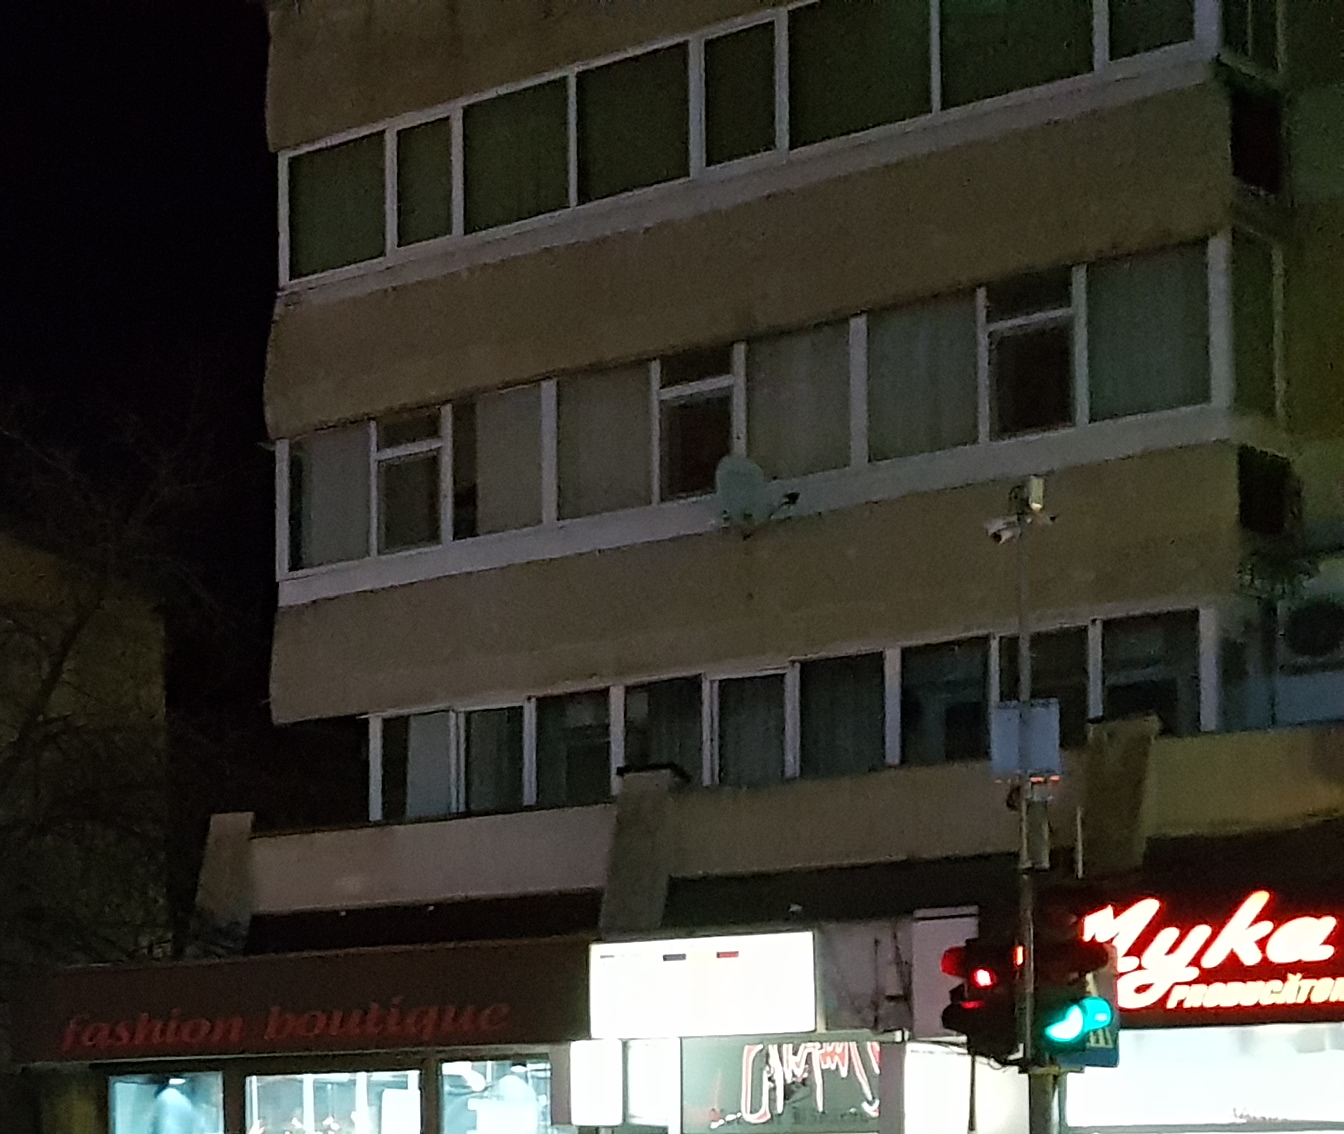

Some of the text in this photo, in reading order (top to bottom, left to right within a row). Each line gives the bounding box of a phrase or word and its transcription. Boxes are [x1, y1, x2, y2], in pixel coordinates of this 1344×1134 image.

[1082, 890, 1337, 1009] Myka
[60, 996, 511, 1052] fashion boutique
